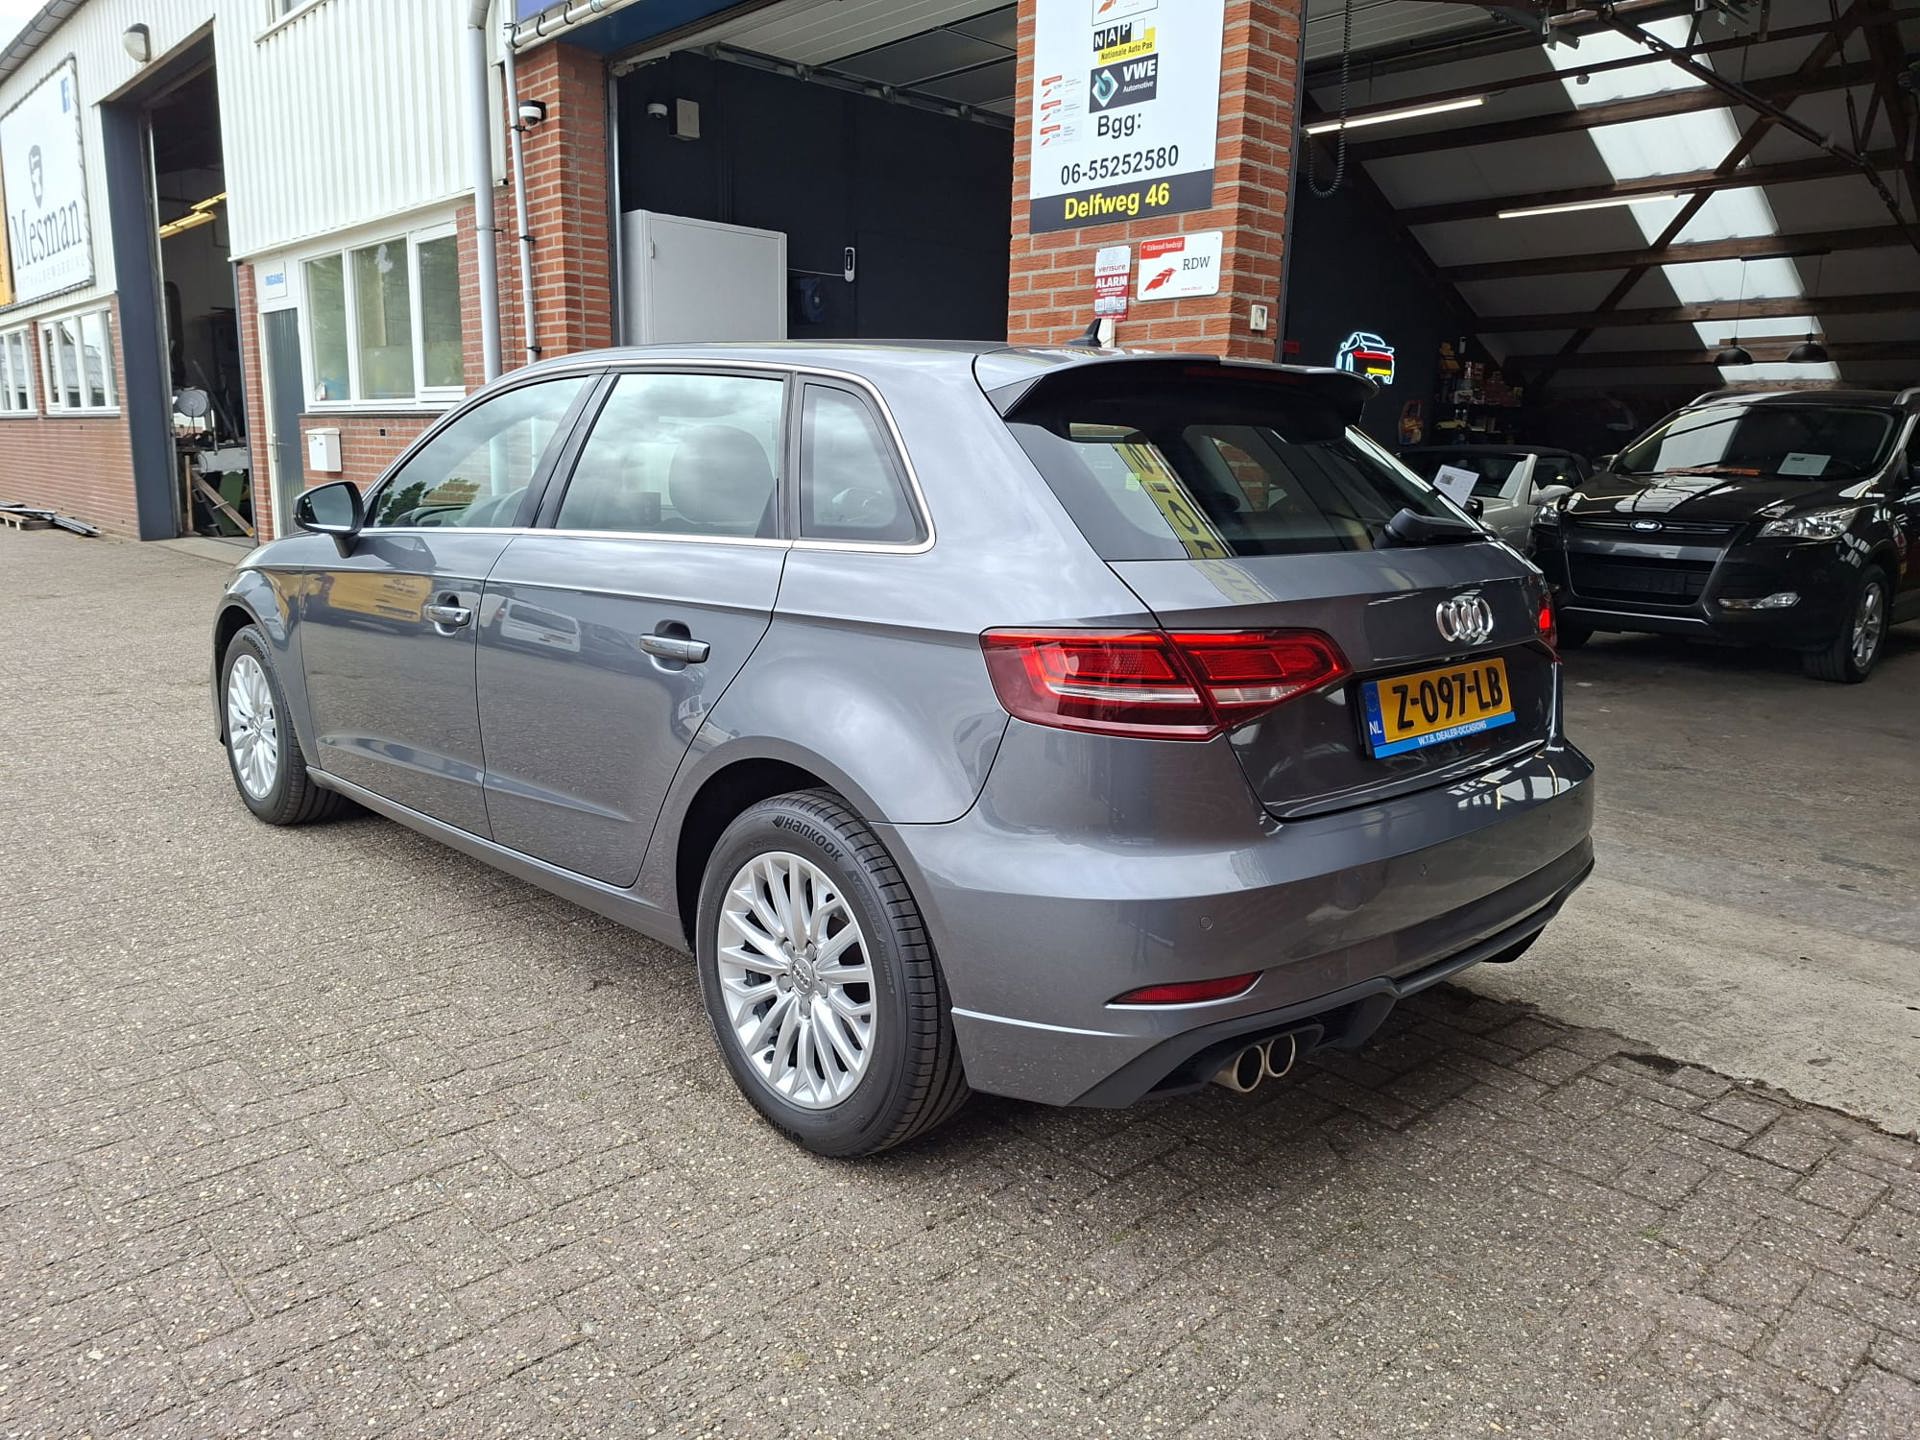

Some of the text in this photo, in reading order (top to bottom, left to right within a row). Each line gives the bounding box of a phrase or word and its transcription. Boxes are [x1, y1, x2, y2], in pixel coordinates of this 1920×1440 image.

[1095, 24, 1130, 48] NAP
[1101, 41, 1153, 60] Nationale Auto Pas
[1122, 59, 1156, 82] VWE
[1123, 81, 1154, 93] Automotive
[1097, 112, 1142, 139] Bgg:
[1061, 144, 1179, 186] 06-55252580
[1064, 182, 1170, 220] Delfweg 46
[11, 199, 82, 270] Mesman
[1182, 255, 1211, 271] RDW
[1095, 275, 1128, 289] ALARM
[1392, 666, 1503, 731] Z-097-LB
[1369, 721, 1382, 736] NL
